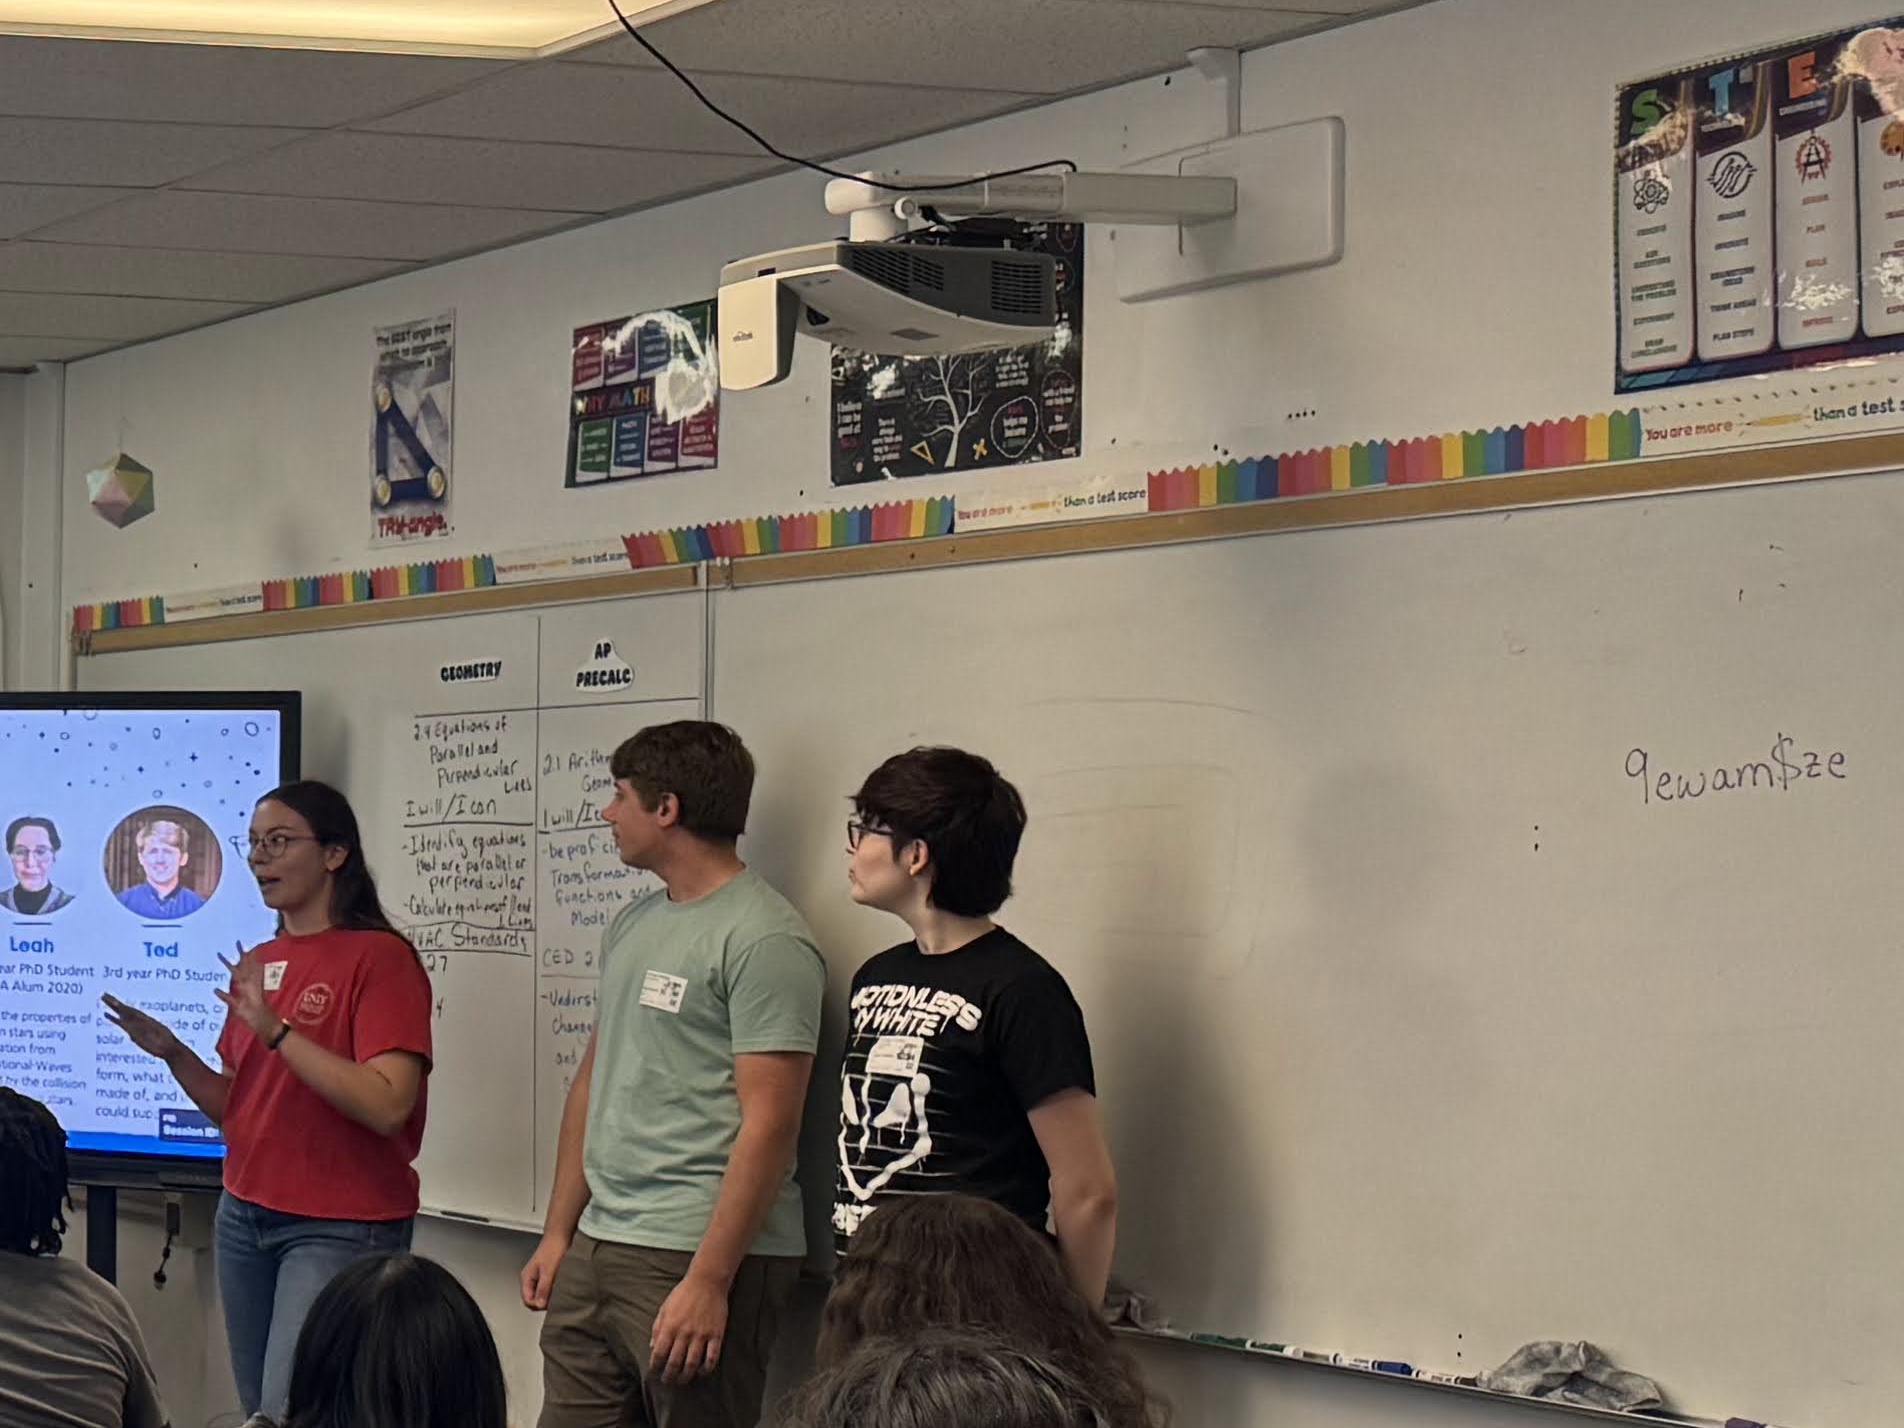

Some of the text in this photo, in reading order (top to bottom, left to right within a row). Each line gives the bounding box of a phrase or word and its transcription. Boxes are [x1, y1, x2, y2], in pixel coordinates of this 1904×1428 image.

[1787, 51, 1820, 99] E
[1709, 68, 1734, 116] T
[1645, 427, 1667, 441] You
[1670, 425, 1692, 437] are
[1695, 422, 1733, 434] more
[1813, 407, 1845, 422] than
[1862, 397, 1895, 415] test
[595, 642, 611, 659] AP
[440, 661, 502, 682] GEOMETRY
[576, 668, 631, 687] PRECALC
[10, 936, 54, 954] Leah
[143, 941, 179, 957] Ted
[20, 963, 42, 975] PhD
[47, 965, 95, 977] Student
[103, 966, 122, 978] 3rd
[126, 969, 152, 981] year
[156, 969, 180, 980] PhD
[12, 980, 43, 993] Alum
[47, 982, 83, 994] 2020)
[1, 1012, 18, 1021] the
[21, 1013, 76, 1025] properties
[80, 1013, 91, 1024] of
[29, 1043, 56, 1055] from
